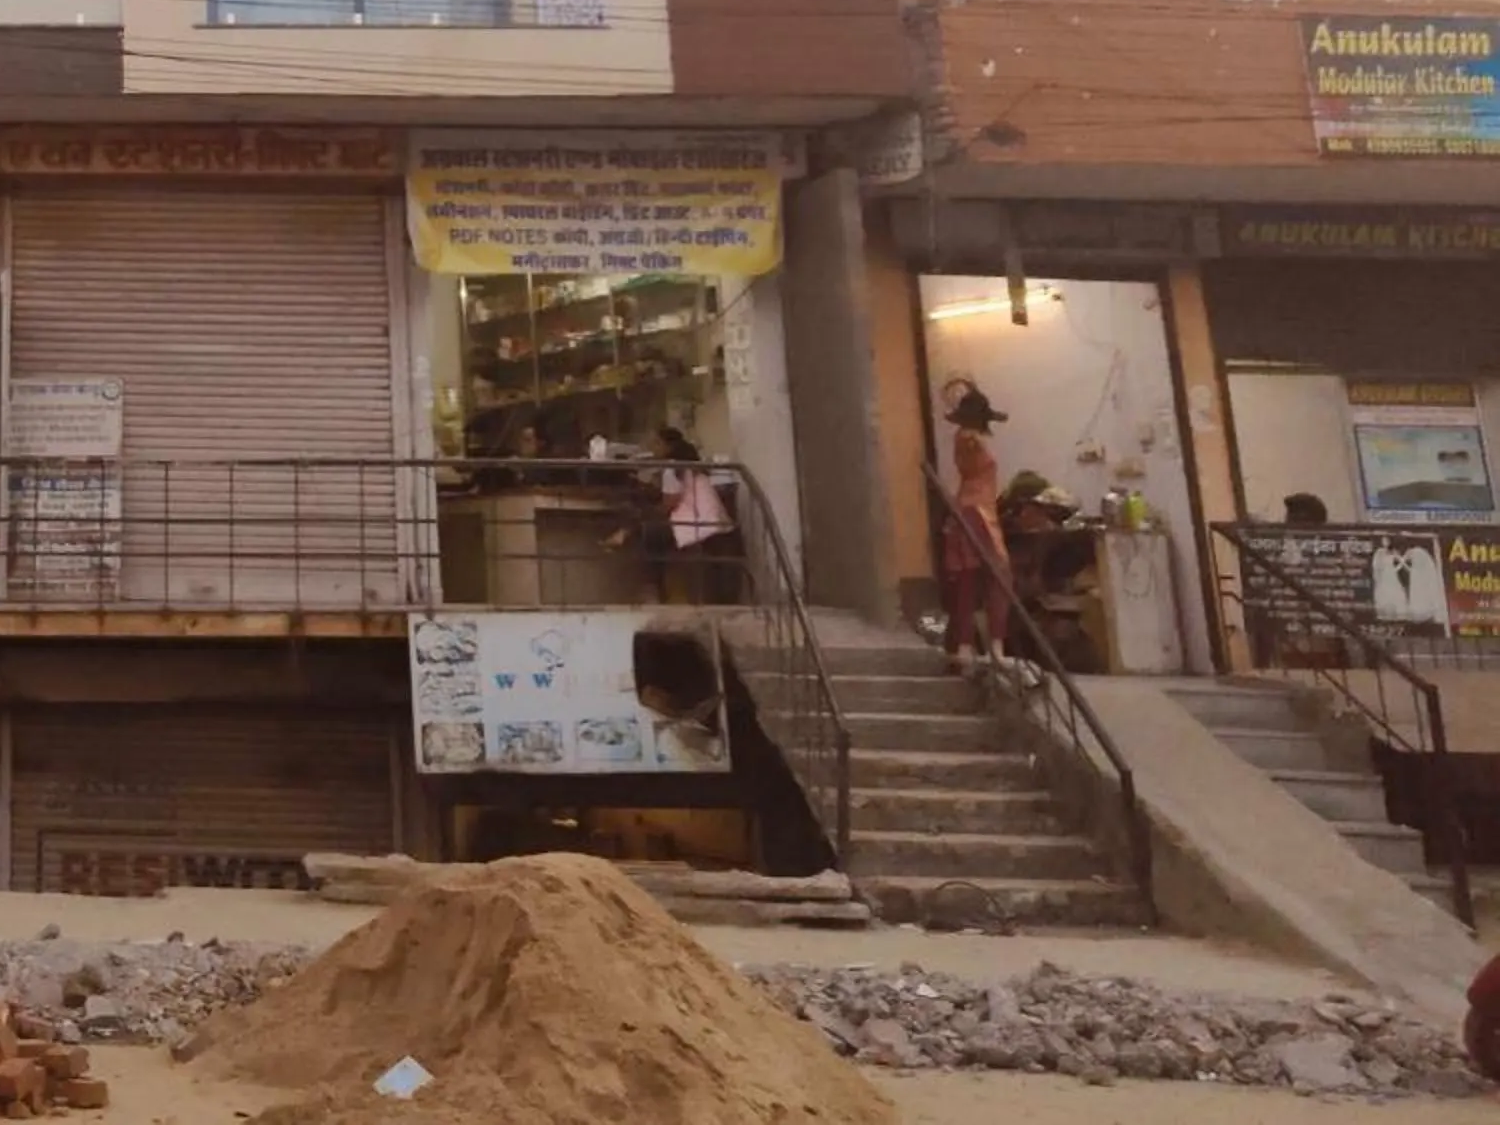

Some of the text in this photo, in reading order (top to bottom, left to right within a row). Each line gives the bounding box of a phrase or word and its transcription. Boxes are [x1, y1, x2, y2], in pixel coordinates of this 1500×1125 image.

[1310, 22, 1492, 57] Anukulam
[1317, 65, 1495, 96] Modular Kitchen
[488, 229, 548, 245] NOTES
